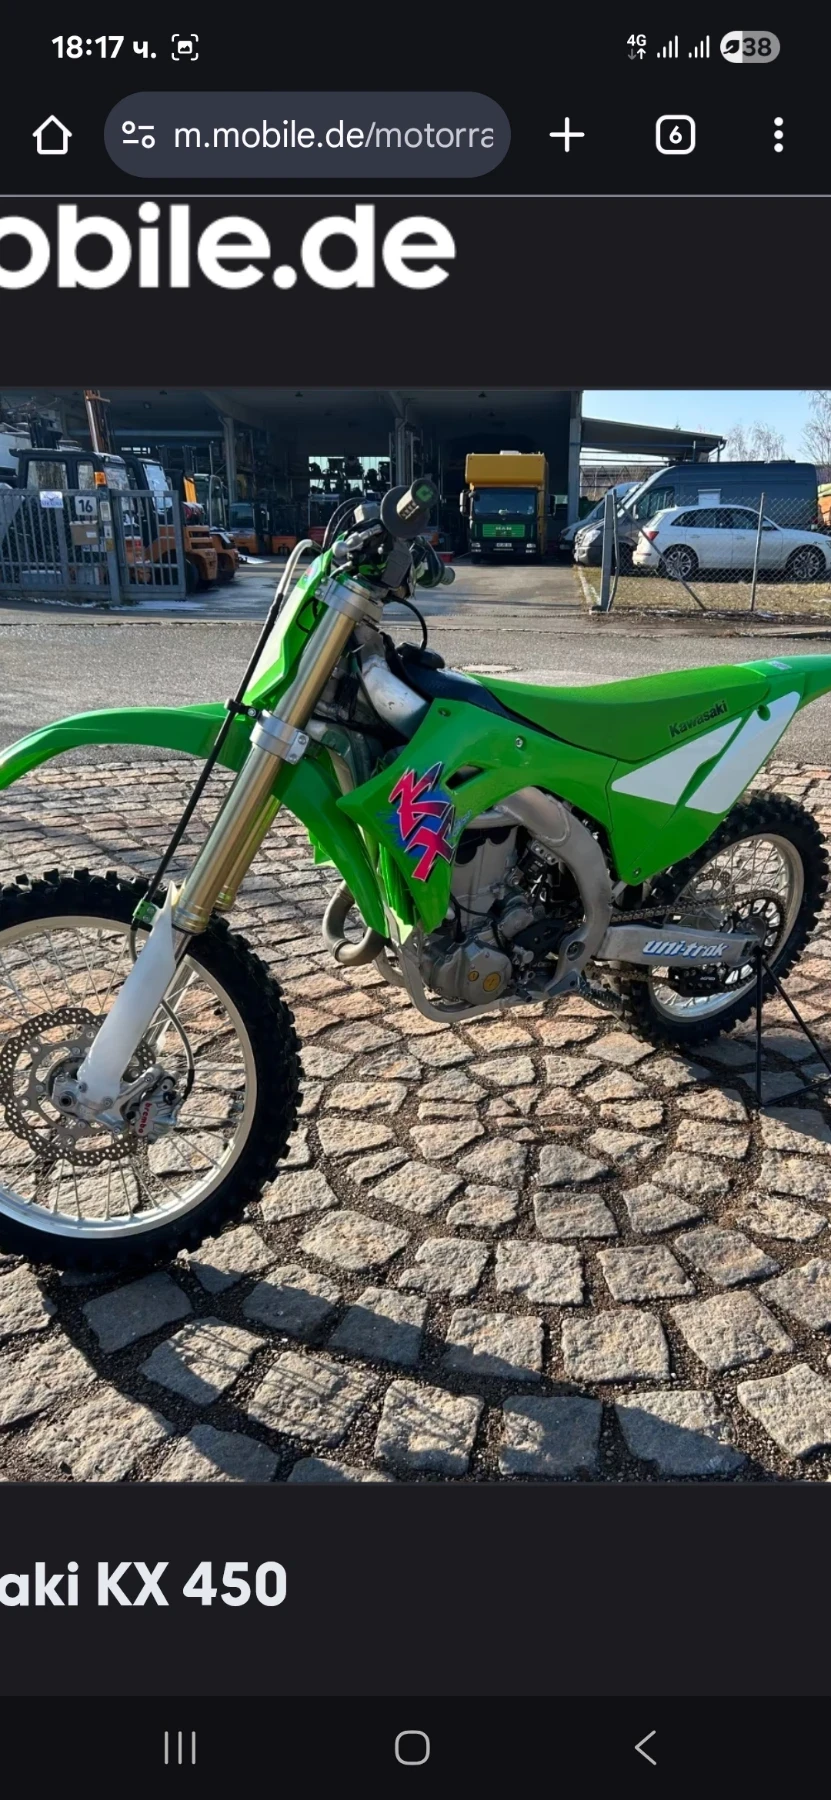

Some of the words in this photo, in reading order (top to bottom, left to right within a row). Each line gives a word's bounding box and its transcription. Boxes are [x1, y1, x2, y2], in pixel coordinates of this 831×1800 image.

[78, 499, 93, 513] 16
[669, 700, 728, 738] Kawasaki
[388, 761, 456, 882] KX
[138, 1102, 152, 1133] brembo
